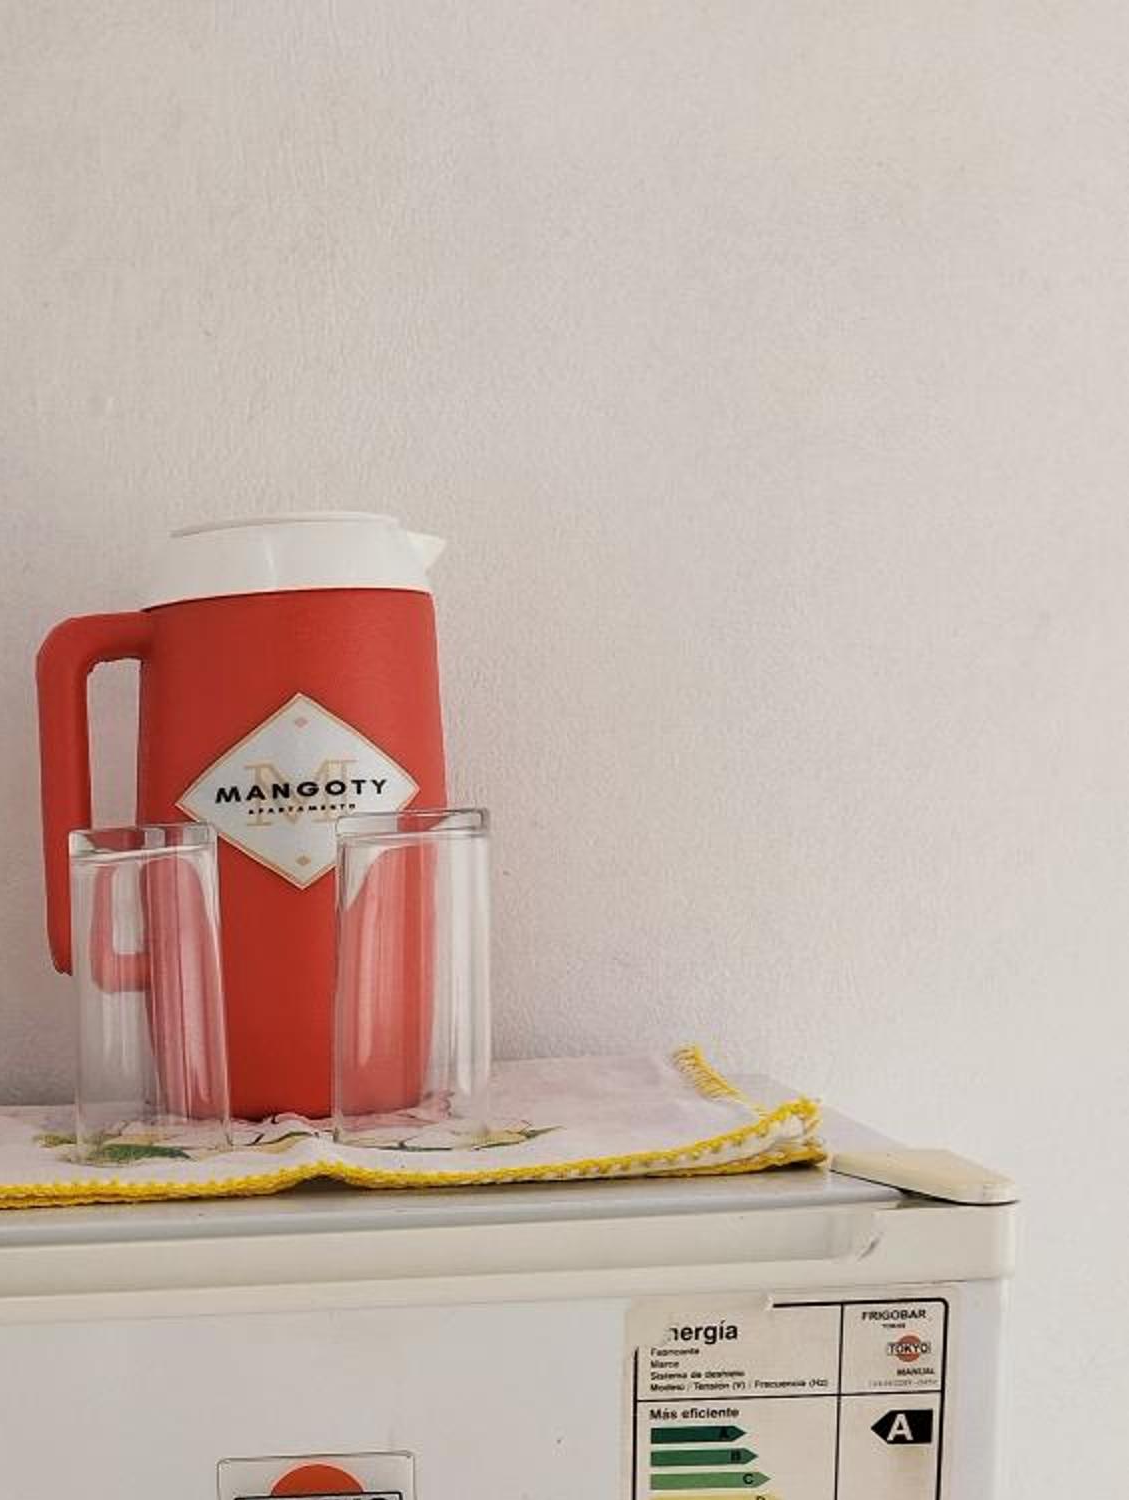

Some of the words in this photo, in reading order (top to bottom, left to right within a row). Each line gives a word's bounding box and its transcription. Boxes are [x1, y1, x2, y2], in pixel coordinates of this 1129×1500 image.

[215, 779, 387, 804] MANGOTY
[862, 1310, 927, 1321] FRIGOBAR
[669, 1320, 738, 1345] nergía
[650, 1347, 700, 1357] Fabricante
[889, 1342, 928, 1354] TOKYO
[650, 1371, 688, 1381] Sistema
[690, 1370, 702, 1379] de
[732, 1381, 746, 1391] (V)
[754, 1379, 806, 1389] Frecuencia
[809, 1378, 828, 1388] (Hz)
[649, 1407, 678, 1420] Más
[682, 1406, 740, 1419] eficiente
[887, 1413, 914, 1441] A
[731, 1450, 742, 1462] B
[742, 1473, 754, 1485] C
